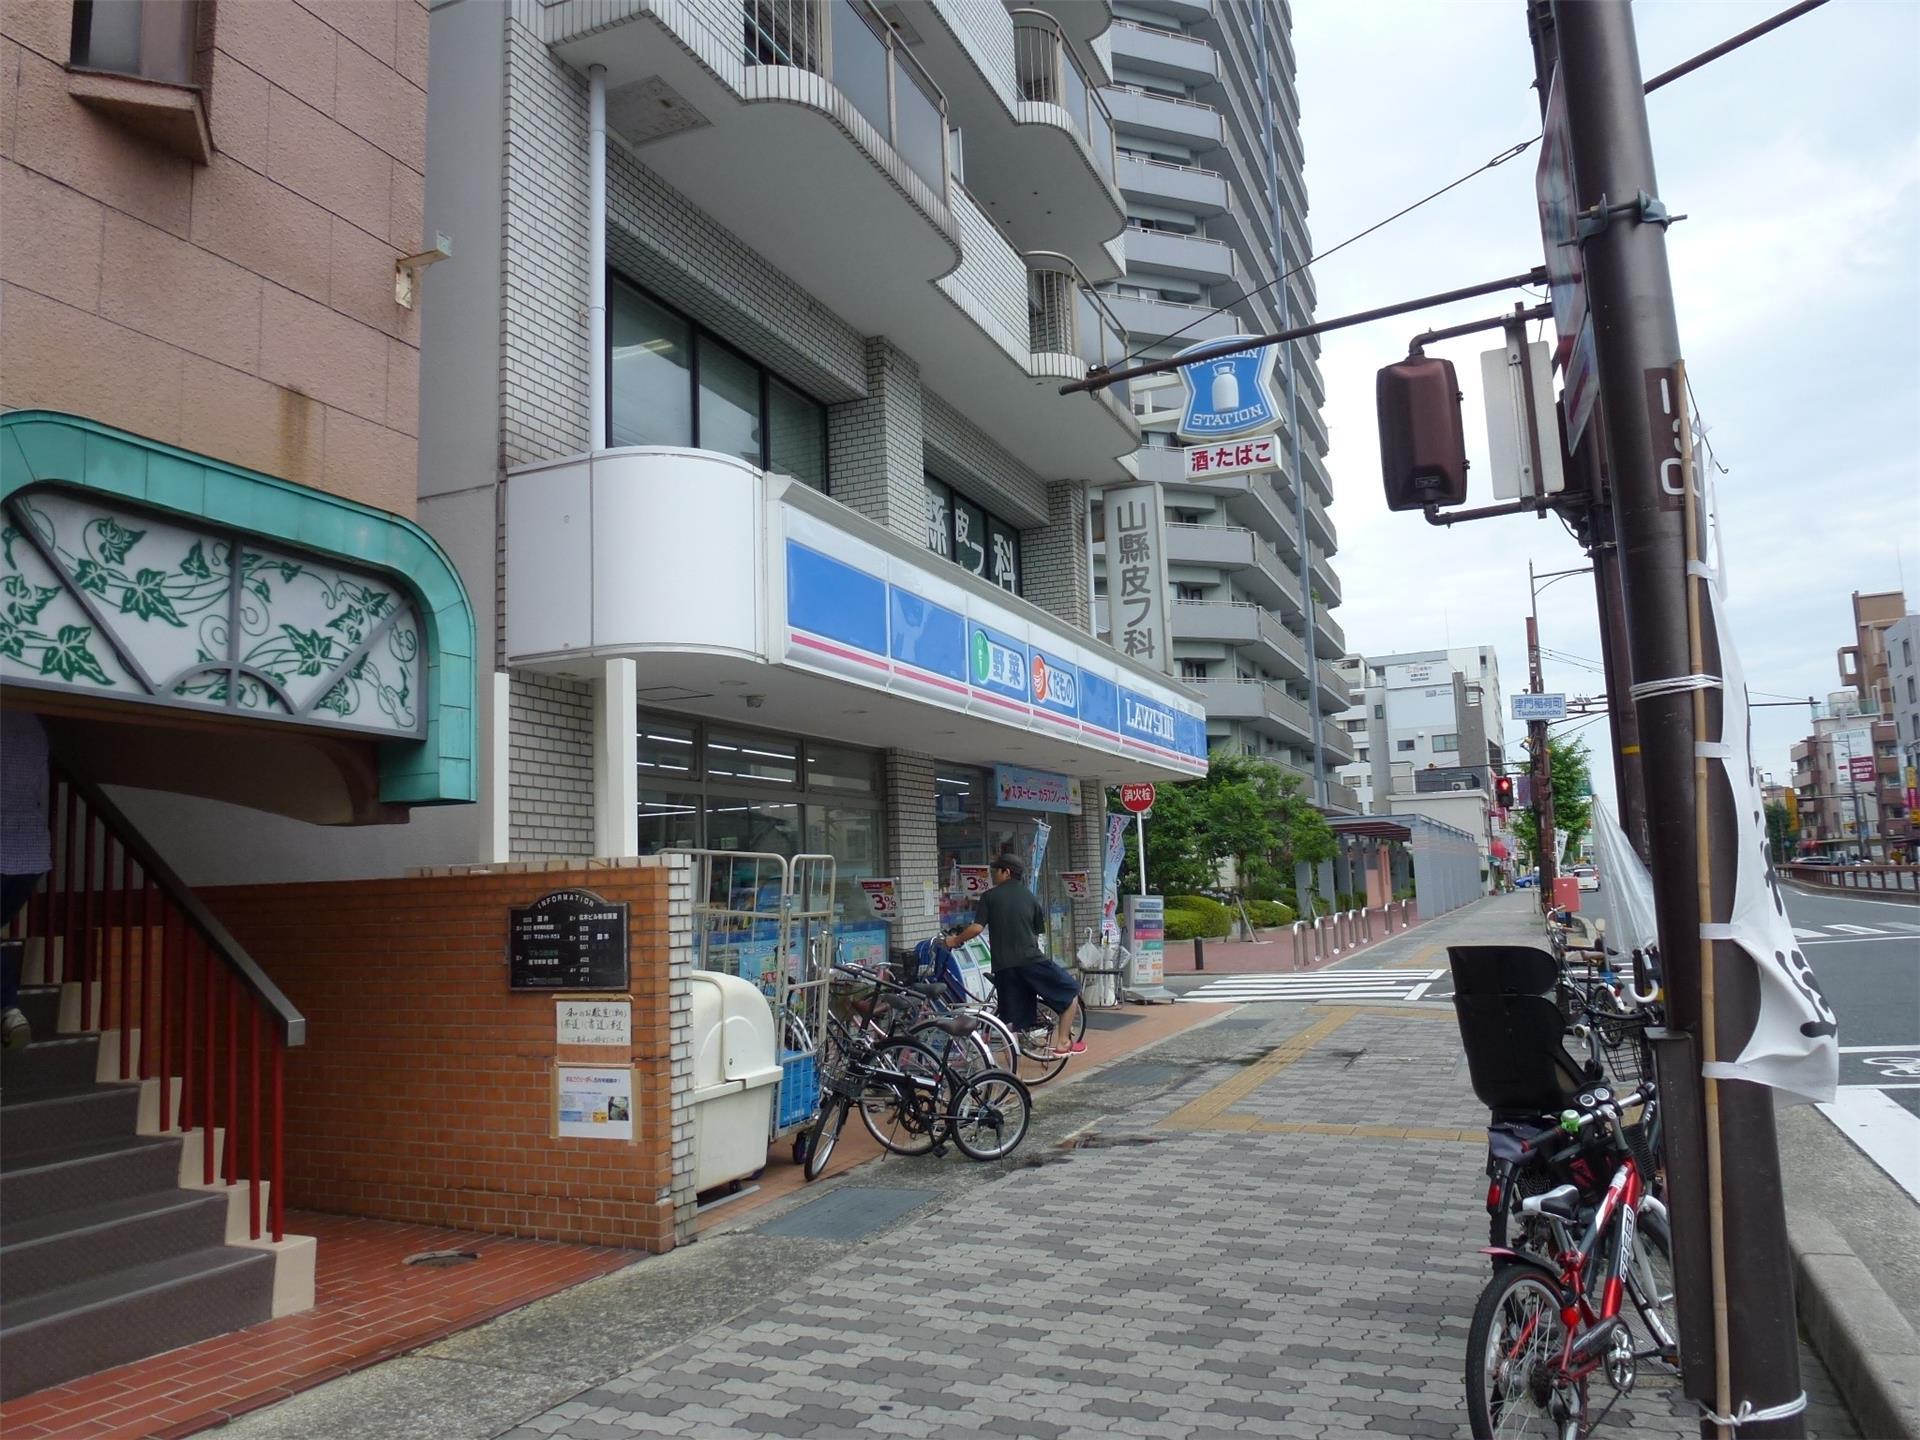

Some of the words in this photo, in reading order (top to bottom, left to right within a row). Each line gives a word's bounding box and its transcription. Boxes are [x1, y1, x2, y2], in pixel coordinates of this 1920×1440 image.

[1191, 403, 1264, 426] STATION
[1117, 501, 1155, 660] 山縣皮フ科
[992, 648, 1021, 686] 野菜
[1047, 671, 1074, 703] くだもの
[1125, 698, 1175, 742] LAWSON
[1124, 788, 1152, 802] 消火栓
[966, 877, 989, 891] 3%
[1068, 882, 1087, 893] 3%
[537, 894, 595, 910] INFORMATION
[871, 894, 897, 910] 3%
